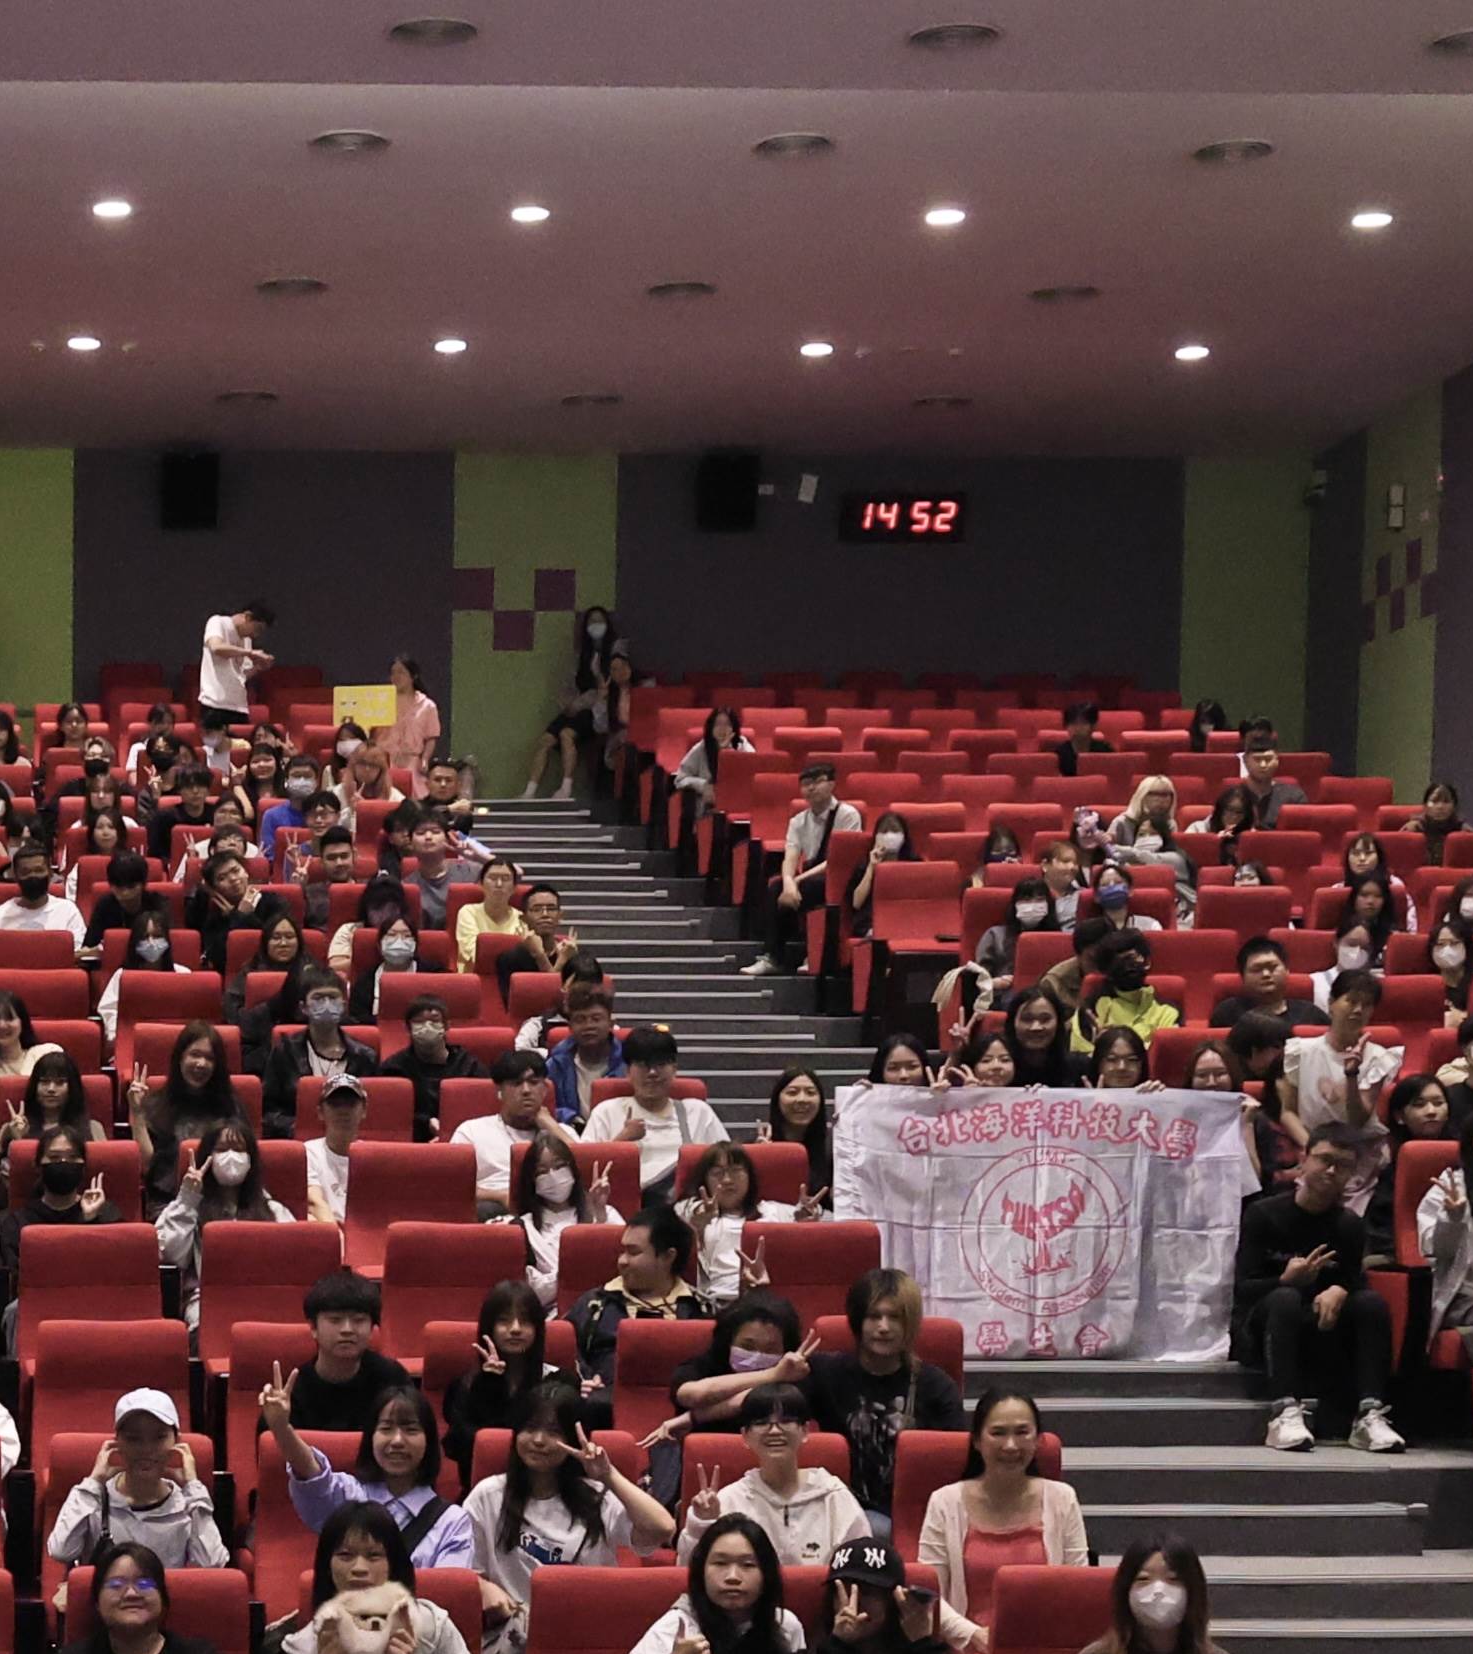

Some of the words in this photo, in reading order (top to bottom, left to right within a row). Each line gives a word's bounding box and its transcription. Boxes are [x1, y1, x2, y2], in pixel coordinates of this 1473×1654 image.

[898, 1099, 1198, 1159] 台北海洋科技大學
[976, 1319, 1109, 1357] 學生會
